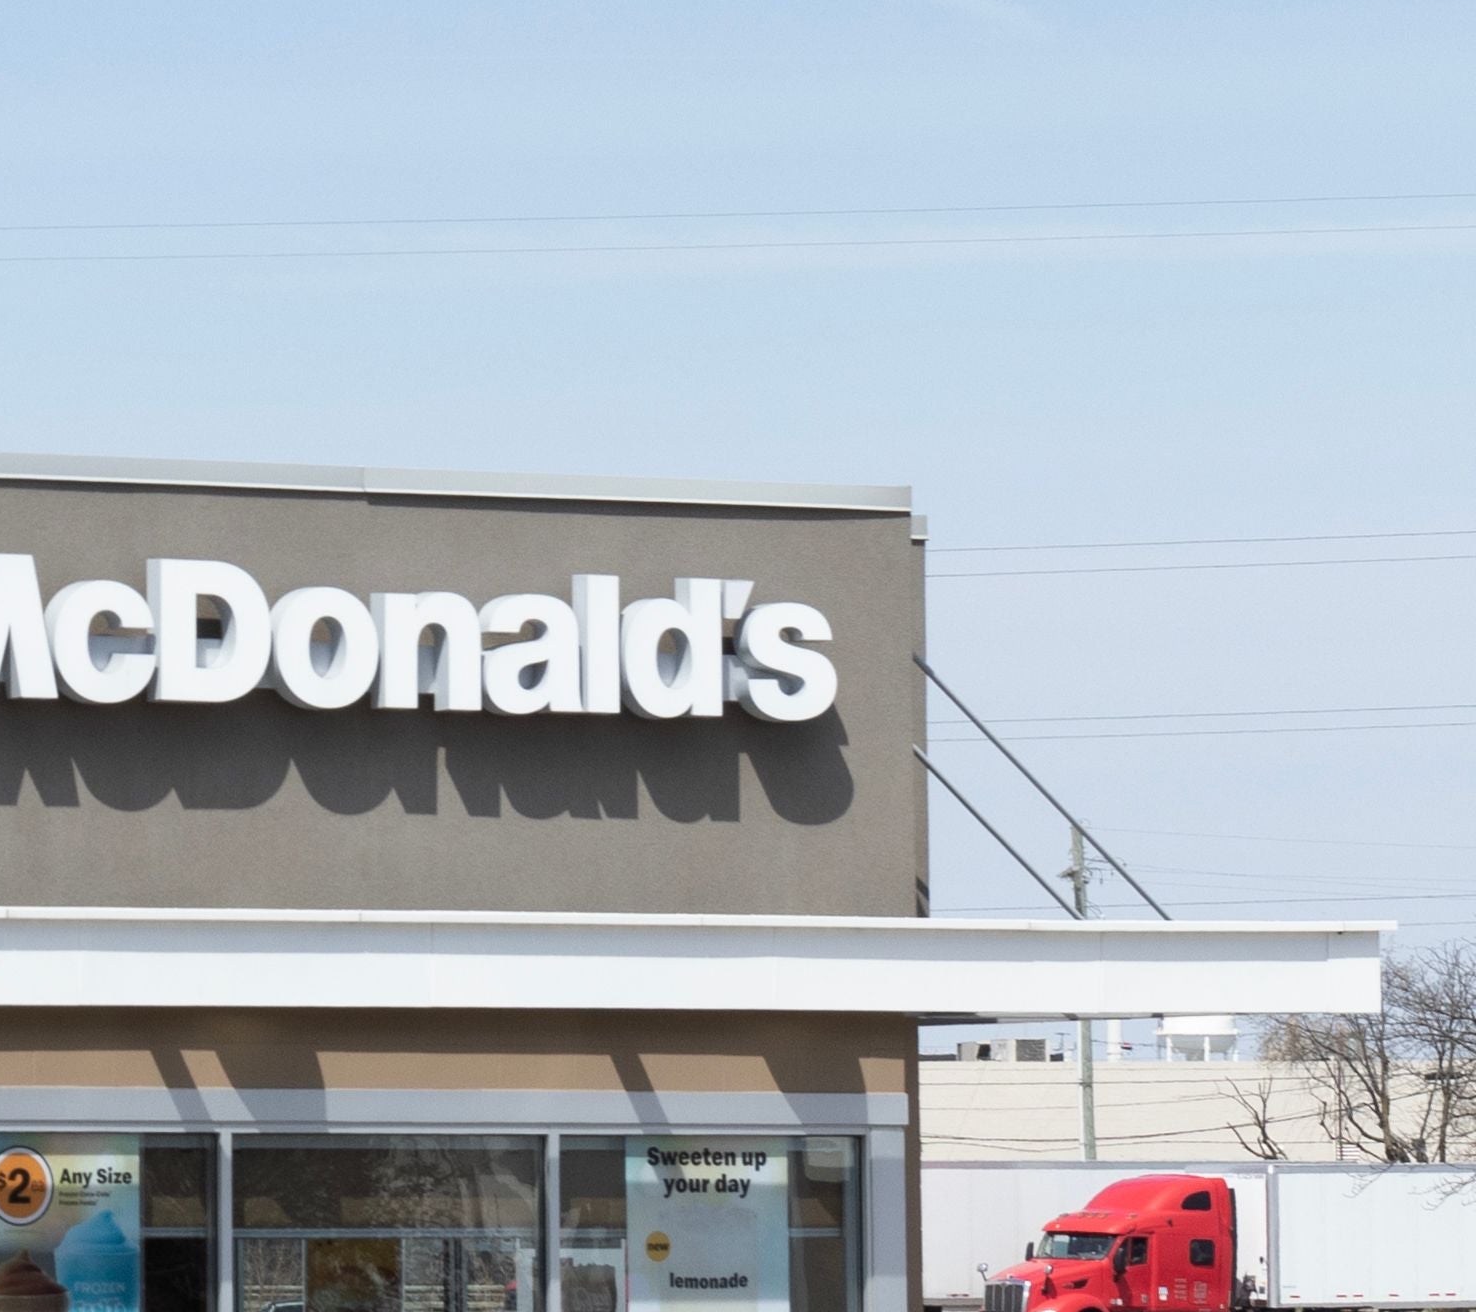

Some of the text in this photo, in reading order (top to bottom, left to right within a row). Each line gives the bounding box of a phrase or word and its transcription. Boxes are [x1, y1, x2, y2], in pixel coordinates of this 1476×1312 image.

[647, 1146, 767, 1171] Sweeten up
[60, 1168, 92, 1187] Any
[97, 1167, 133, 1184] Size
[664, 1173, 751, 1198] your day
[647, 1242, 670, 1251] new
[74, 1282, 125, 1294] FROZEN
[670, 1272, 748, 1288] lemonade
